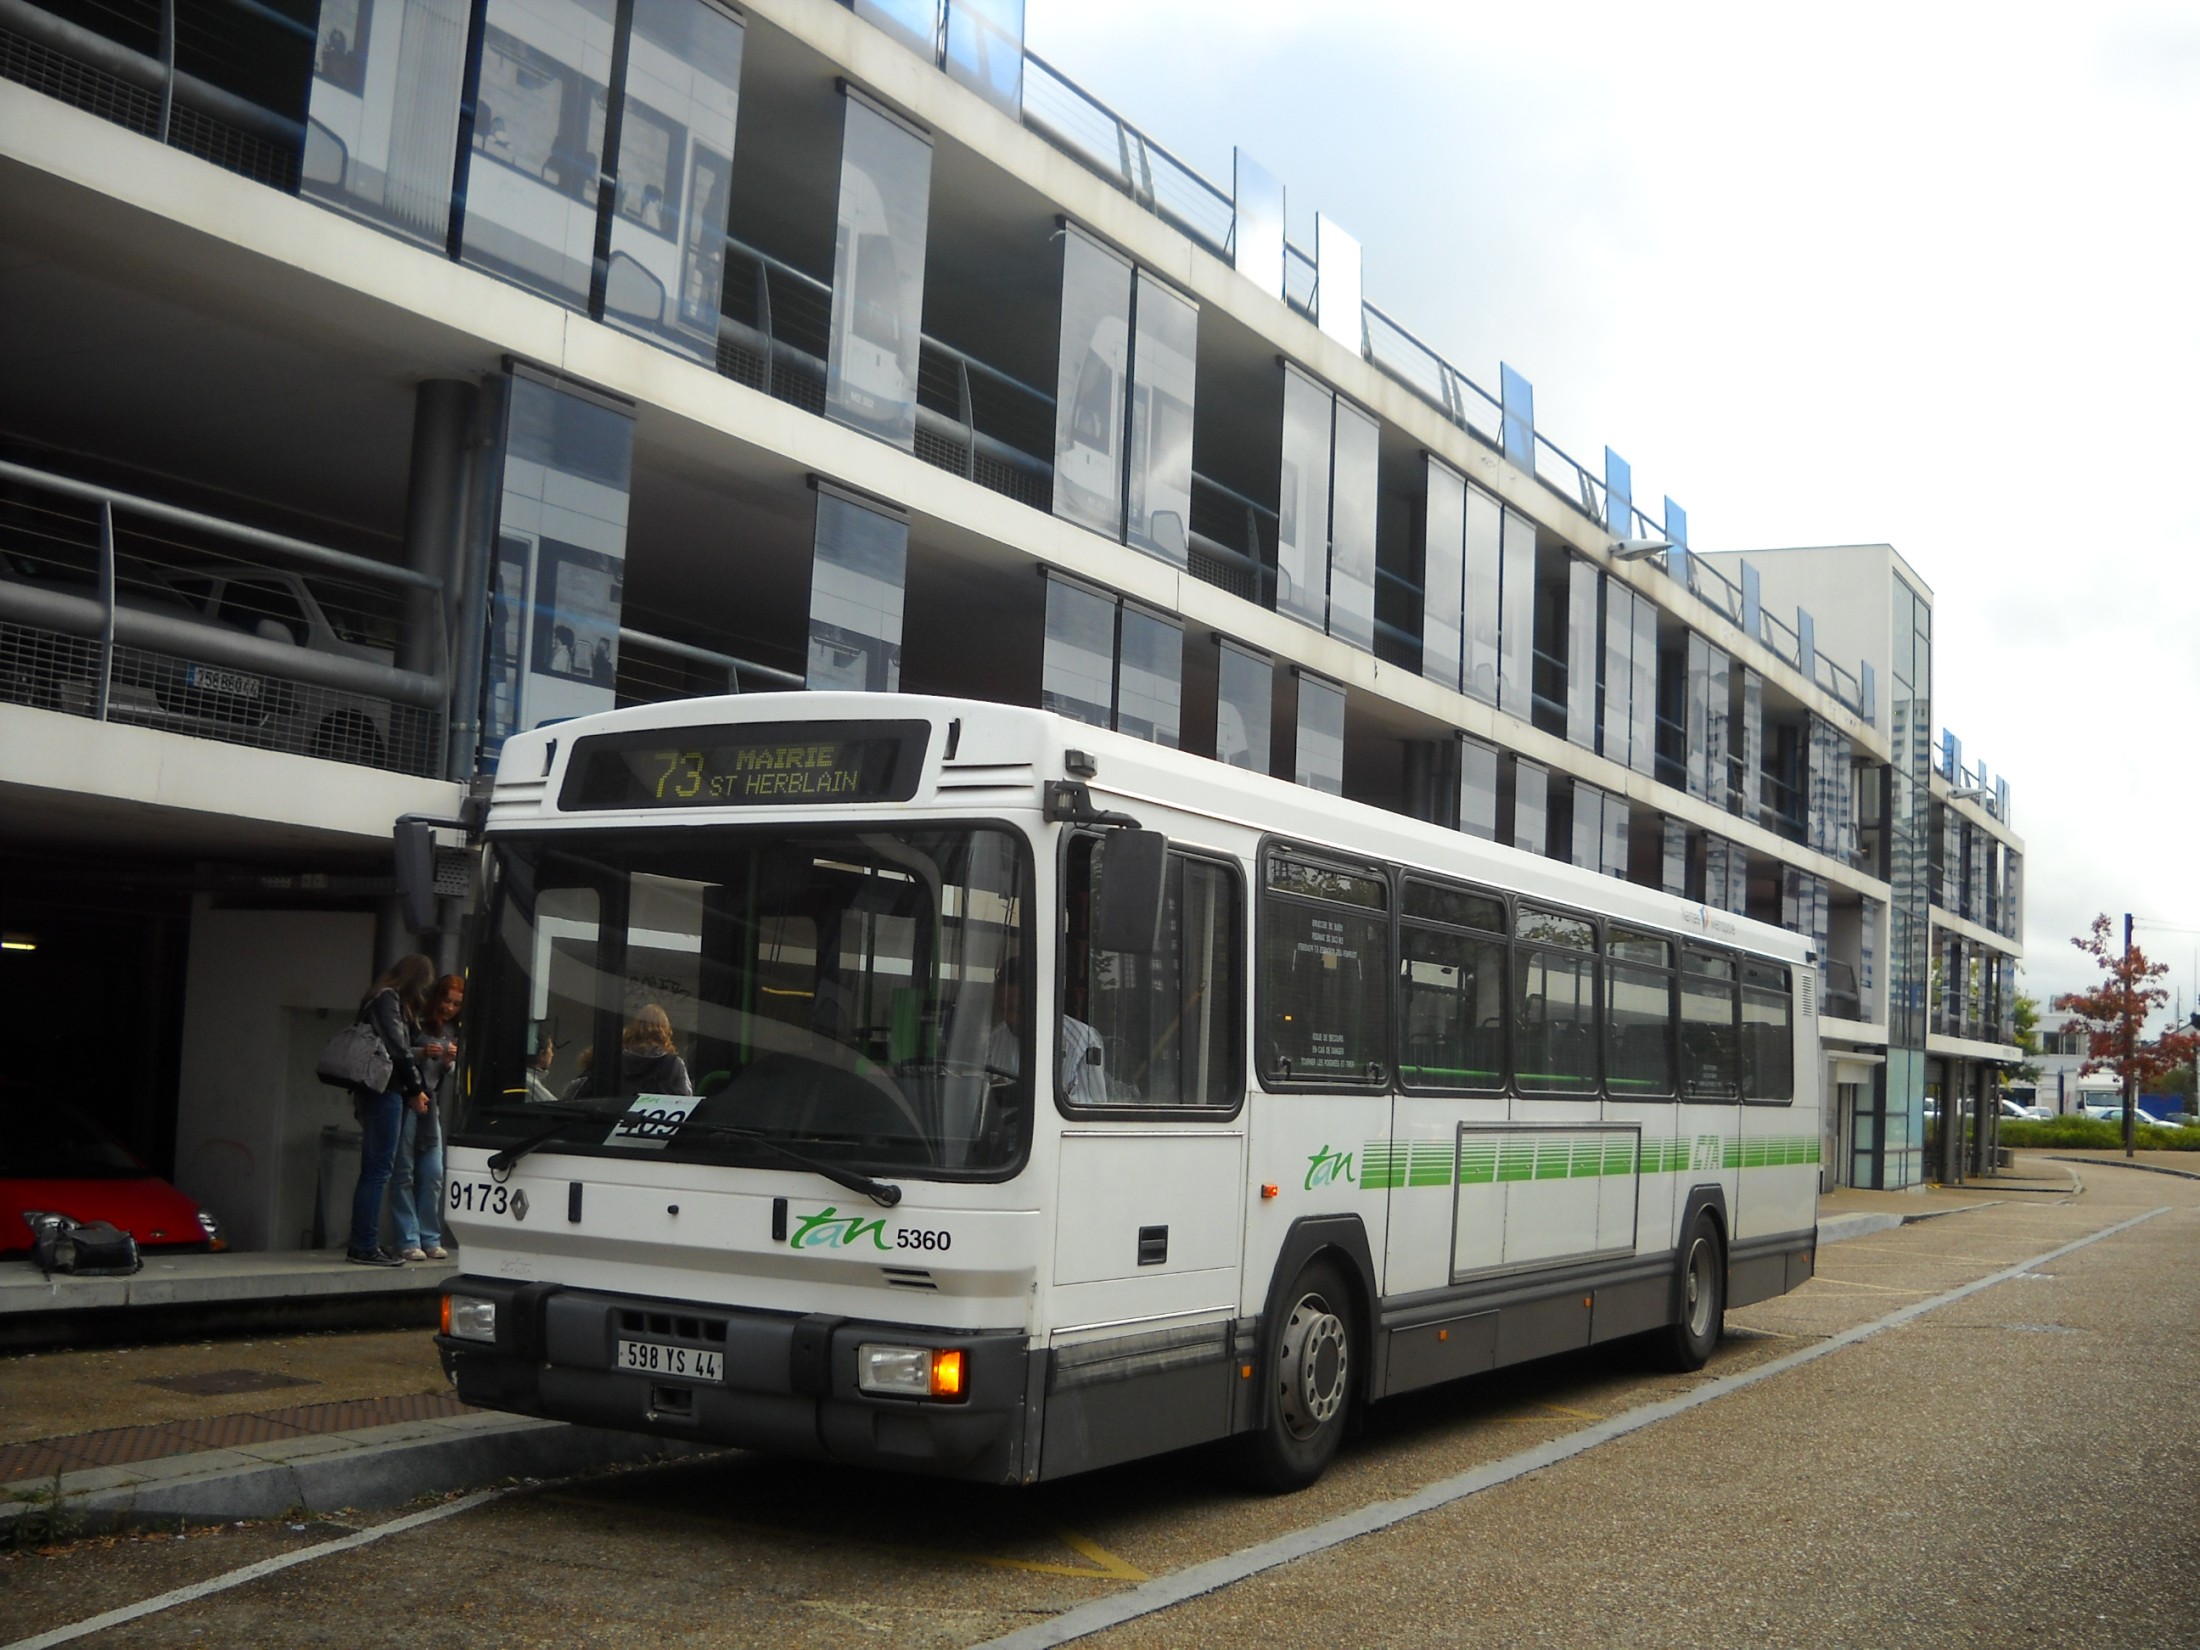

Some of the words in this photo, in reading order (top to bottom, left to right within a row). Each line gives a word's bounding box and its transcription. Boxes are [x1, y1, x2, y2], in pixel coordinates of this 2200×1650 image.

[655, 752, 704, 798] 73
[736, 747, 835, 771] MAIRIE
[709, 775, 738, 796] ST
[745, 771, 858, 795] HERBLAIN
[1304, 1144, 1356, 1191] tan
[450, 1181, 508, 1214] 9173
[790, 1206, 894, 1250] tan
[896, 1229, 952, 1251] 5360
[628, 1343, 659, 1369] 598
[666, 1347, 686, 1373] YS
[695, 1352, 715, 1378] 44
